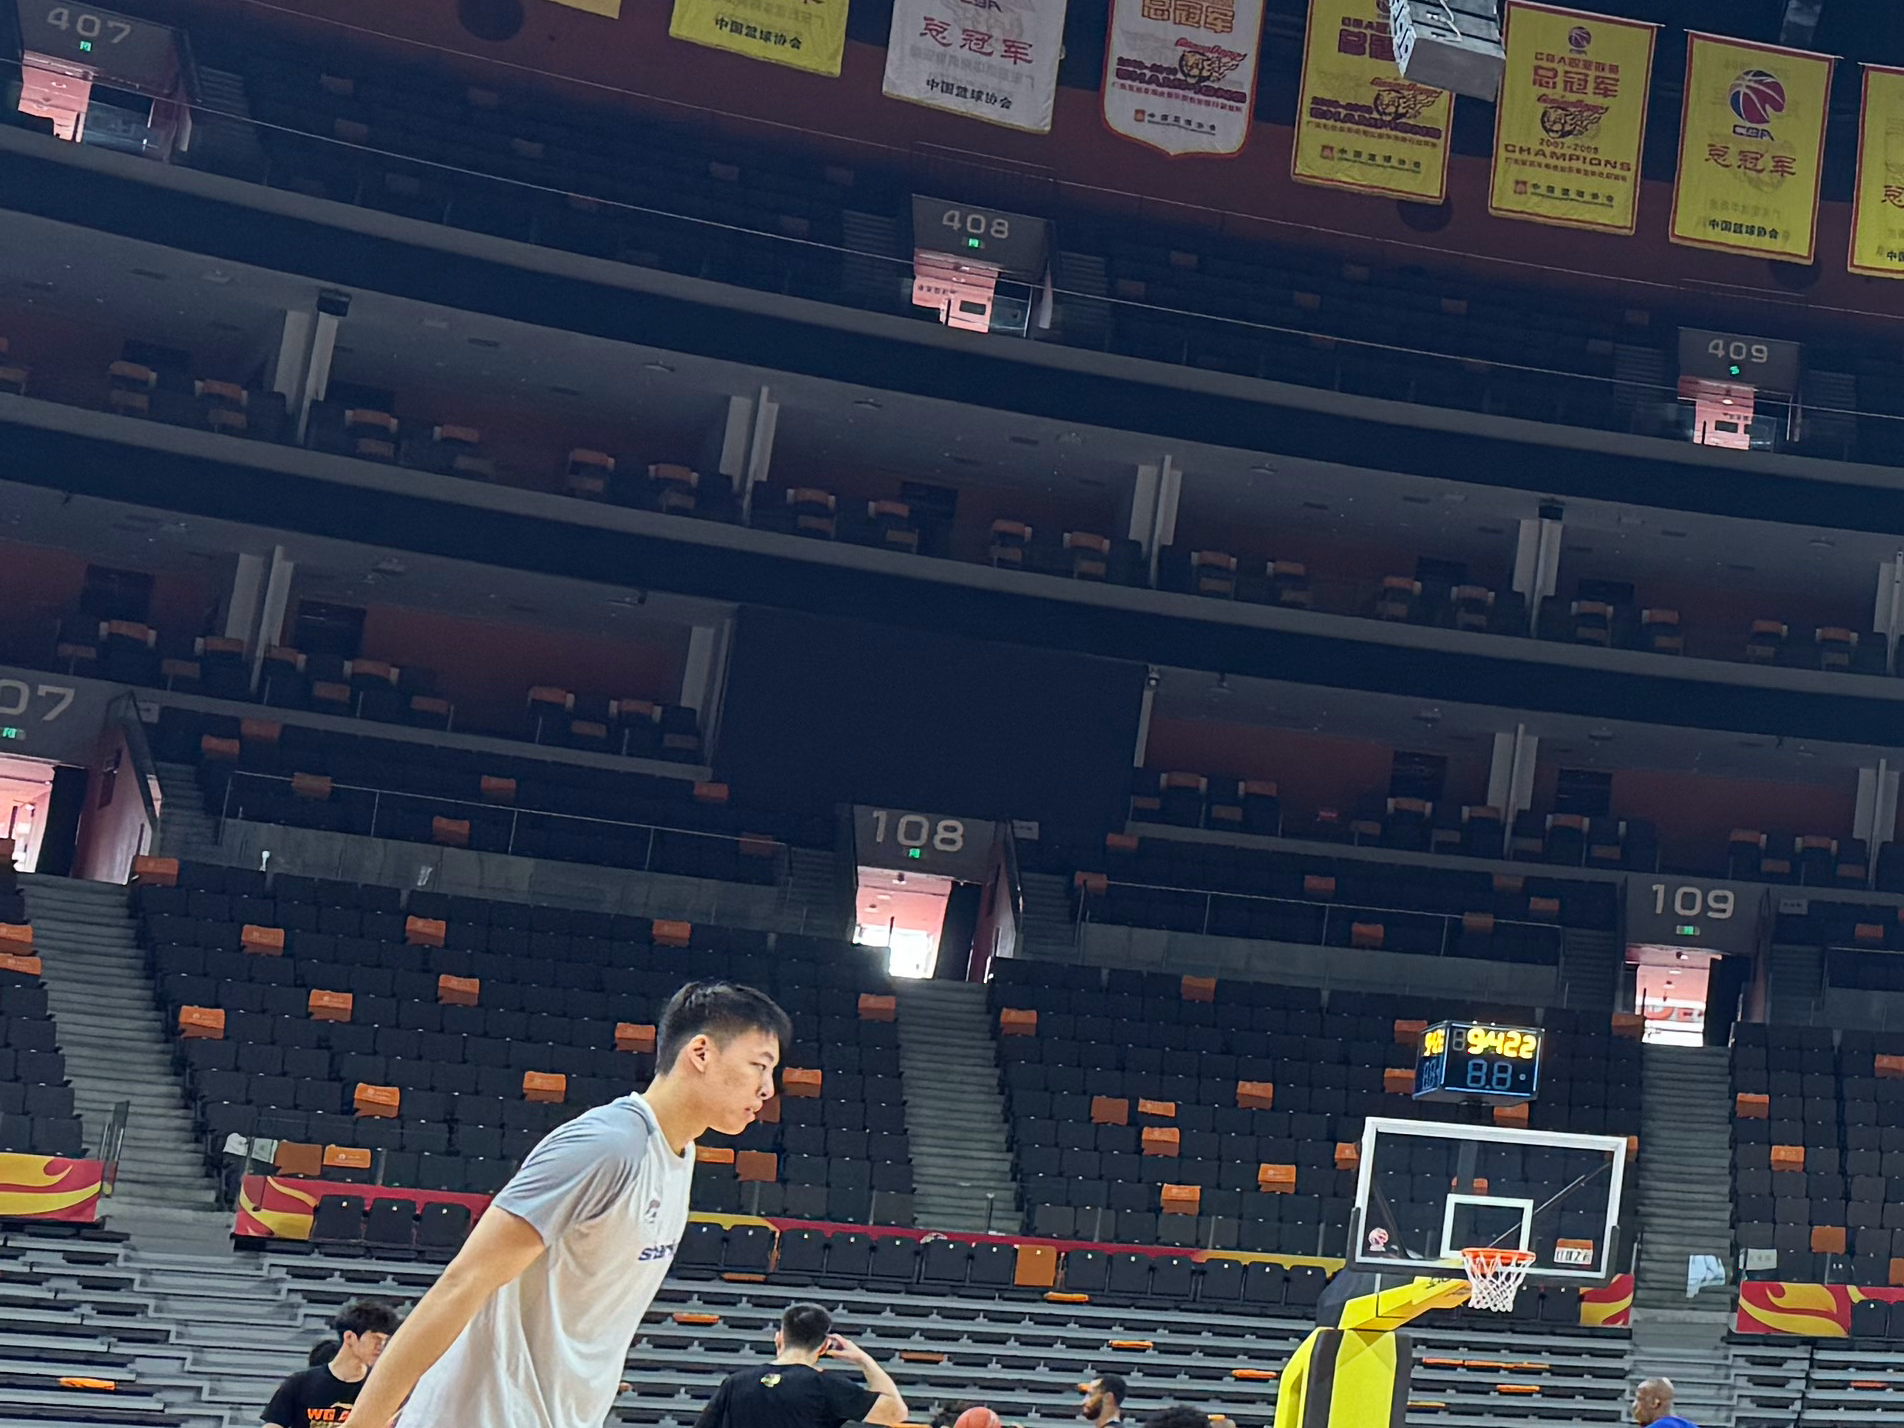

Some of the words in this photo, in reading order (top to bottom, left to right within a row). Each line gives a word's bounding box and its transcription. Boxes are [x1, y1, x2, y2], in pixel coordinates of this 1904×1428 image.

[47, 7, 131, 44] 407
[715, 14, 803, 50] 中国篮球协会
[919, 15, 1034, 65] 总冠军
[926, 77, 1013, 110] 中国篮球协会
[1532, 65, 1620, 99] 总冠军
[1504, 143, 1632, 172] CHAMPIONS
[1704, 143, 1797, 178] 总冠军
[942, 210, 1009, 239] 408
[1708, 218, 1780, 240] 中国篮球协会
[1708, 339, 1768, 363] 409
[872, 810, 964, 852] 108
[1652, 883, 1735, 919] 109
